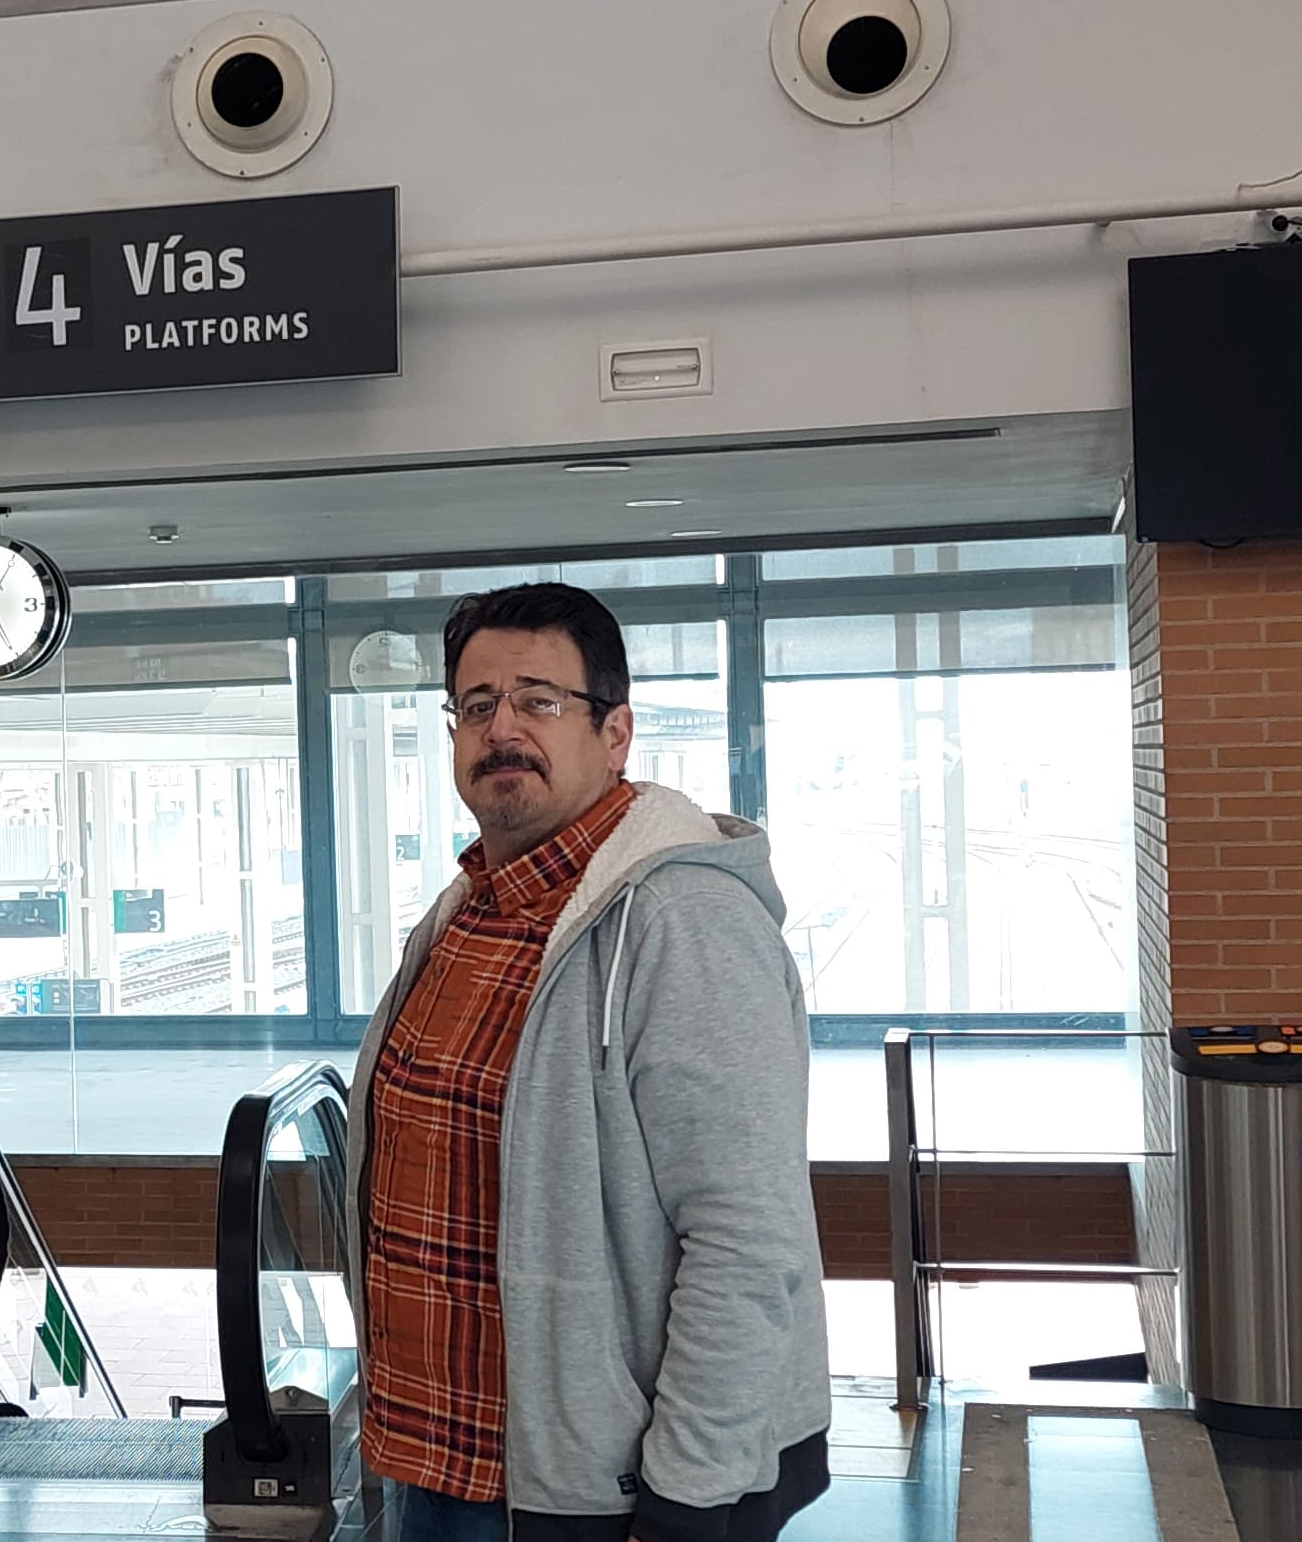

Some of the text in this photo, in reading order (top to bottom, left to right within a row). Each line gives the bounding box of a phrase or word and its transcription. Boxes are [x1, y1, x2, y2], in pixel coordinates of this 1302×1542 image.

[123, 235, 246, 297] Vías
[14, 245, 82, 348] 4
[124, 311, 311, 352] PLATFORMS
[24, 597, 38, 612] 3
[148, 910, 162, 932] 3
